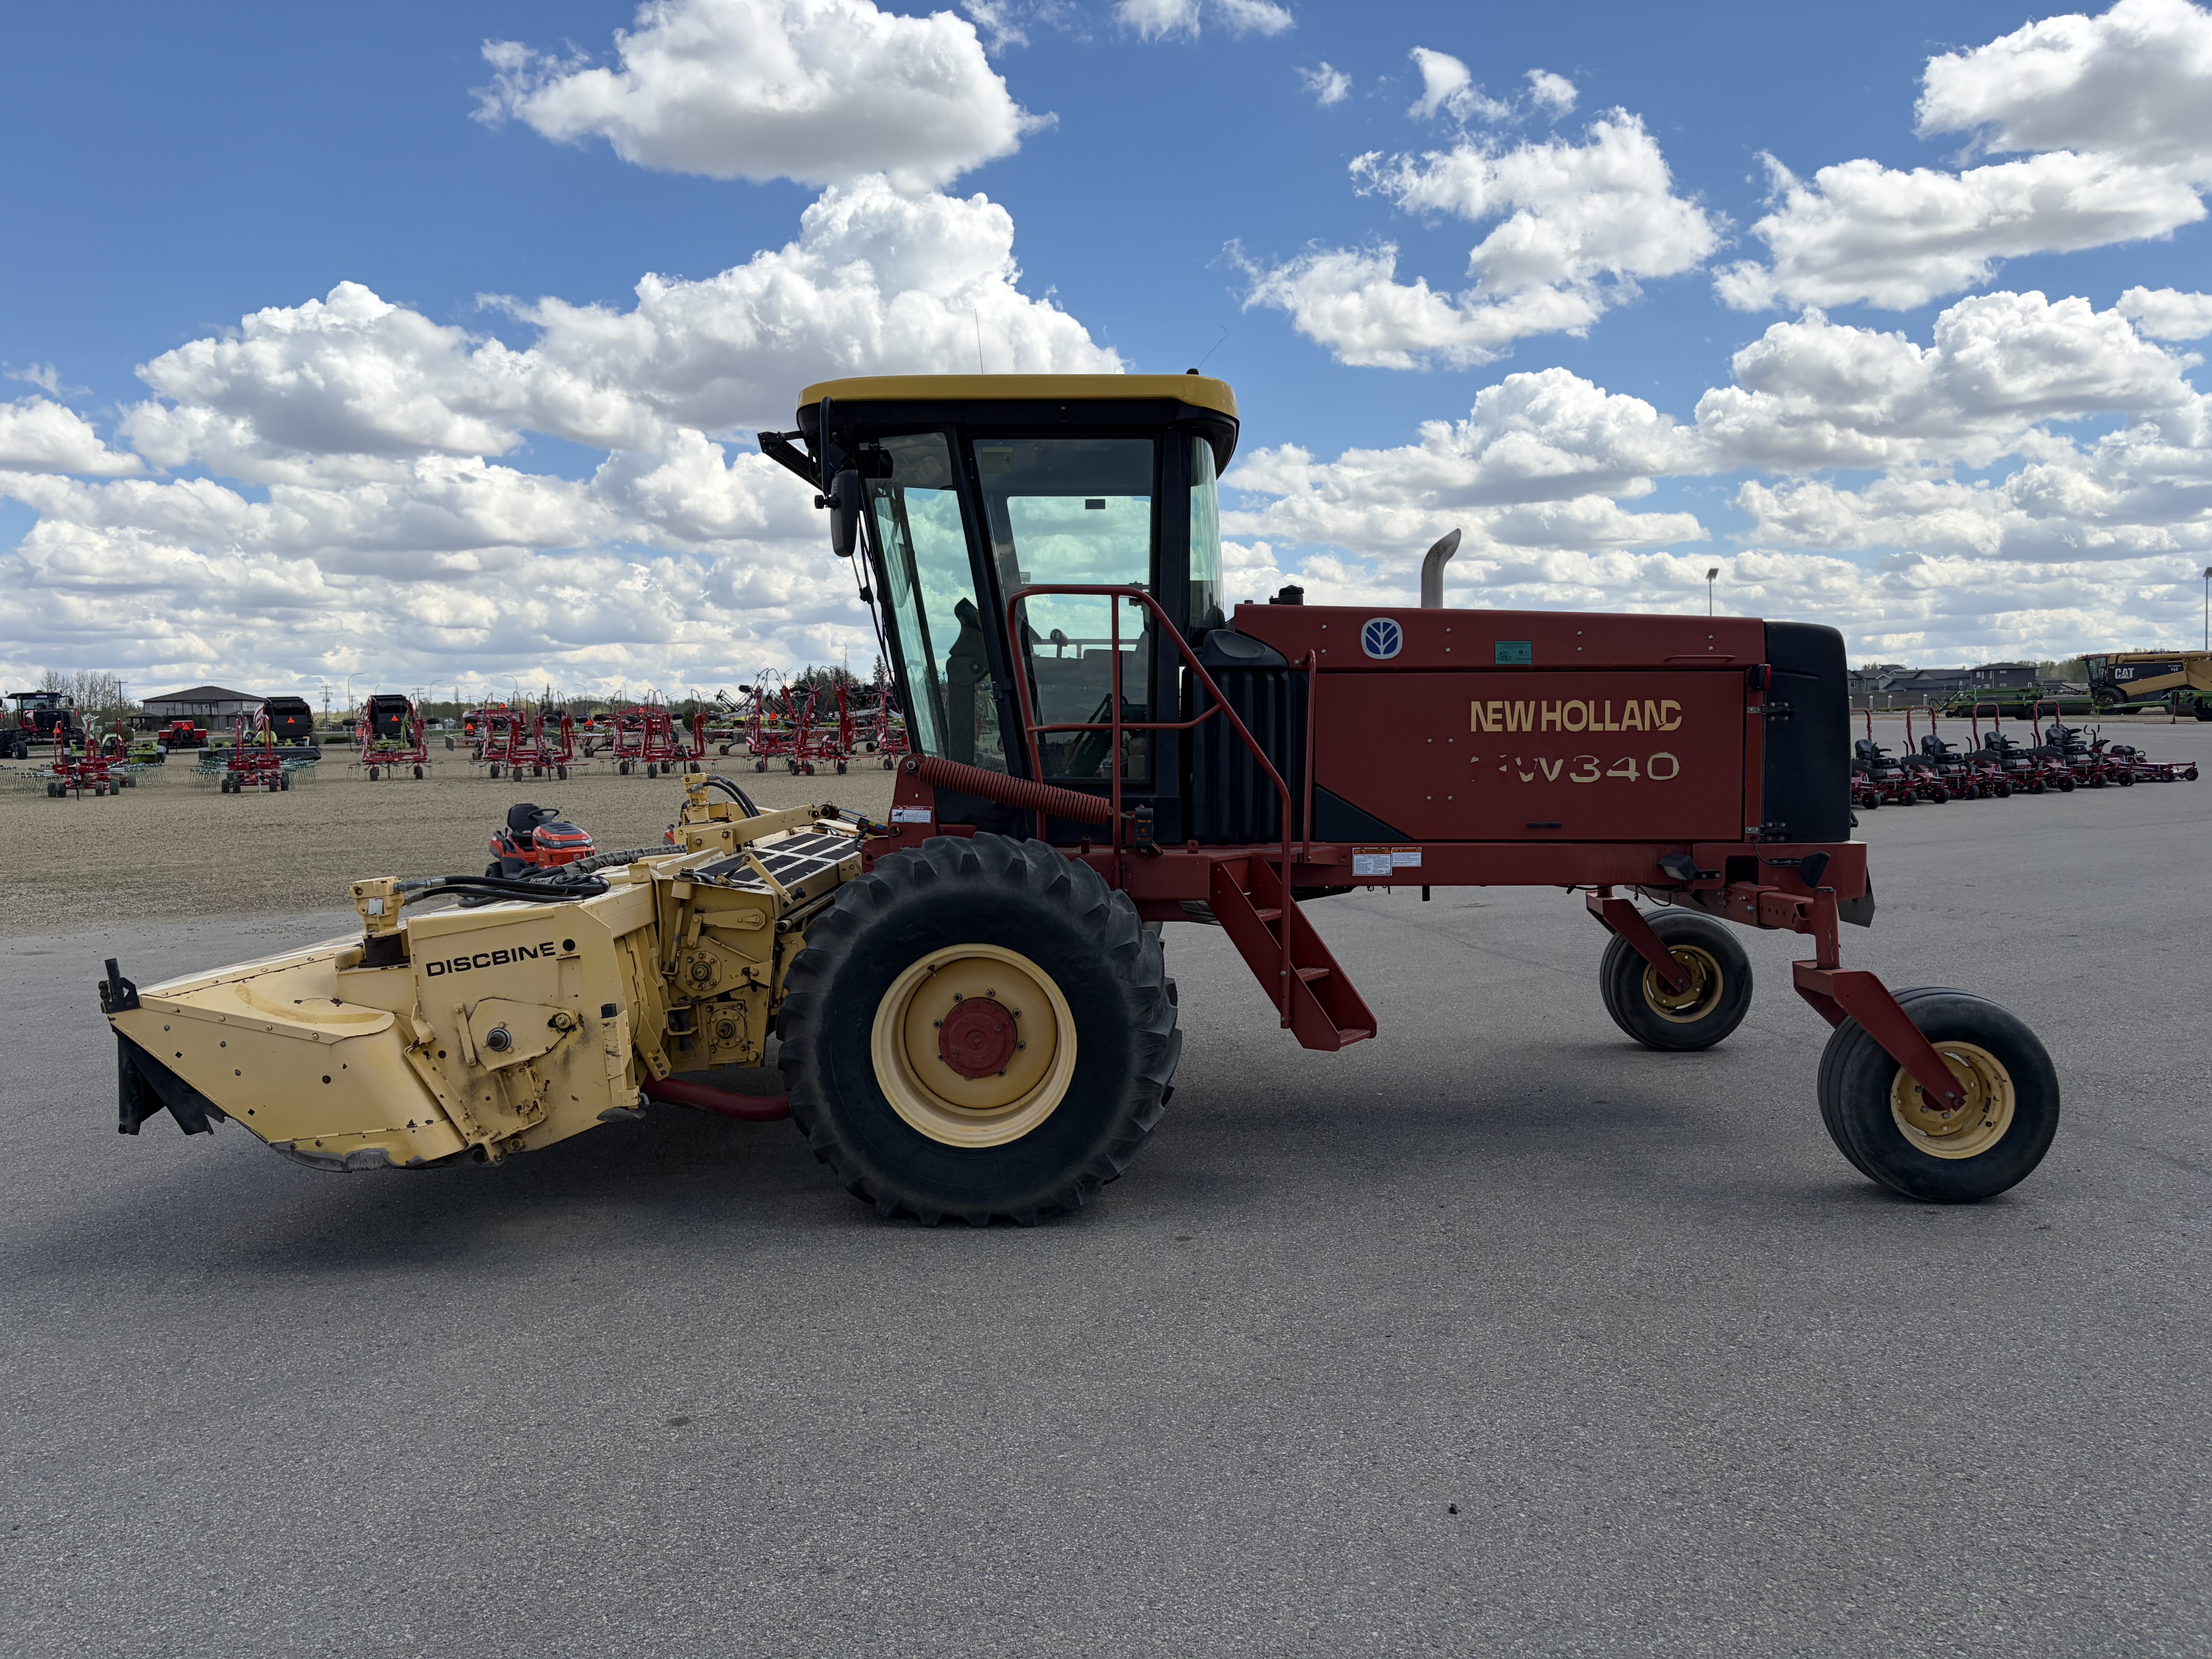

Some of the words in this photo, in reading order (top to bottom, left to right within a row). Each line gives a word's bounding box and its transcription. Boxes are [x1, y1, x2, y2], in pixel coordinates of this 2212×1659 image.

[2115, 668, 2135, 679] CAT
[1471, 700, 1535, 732] NEW
[1541, 700, 1683, 732] HOLLAND
[1470, 752, 1680, 783] W340
[426, 941, 556, 977] DISCBINE
